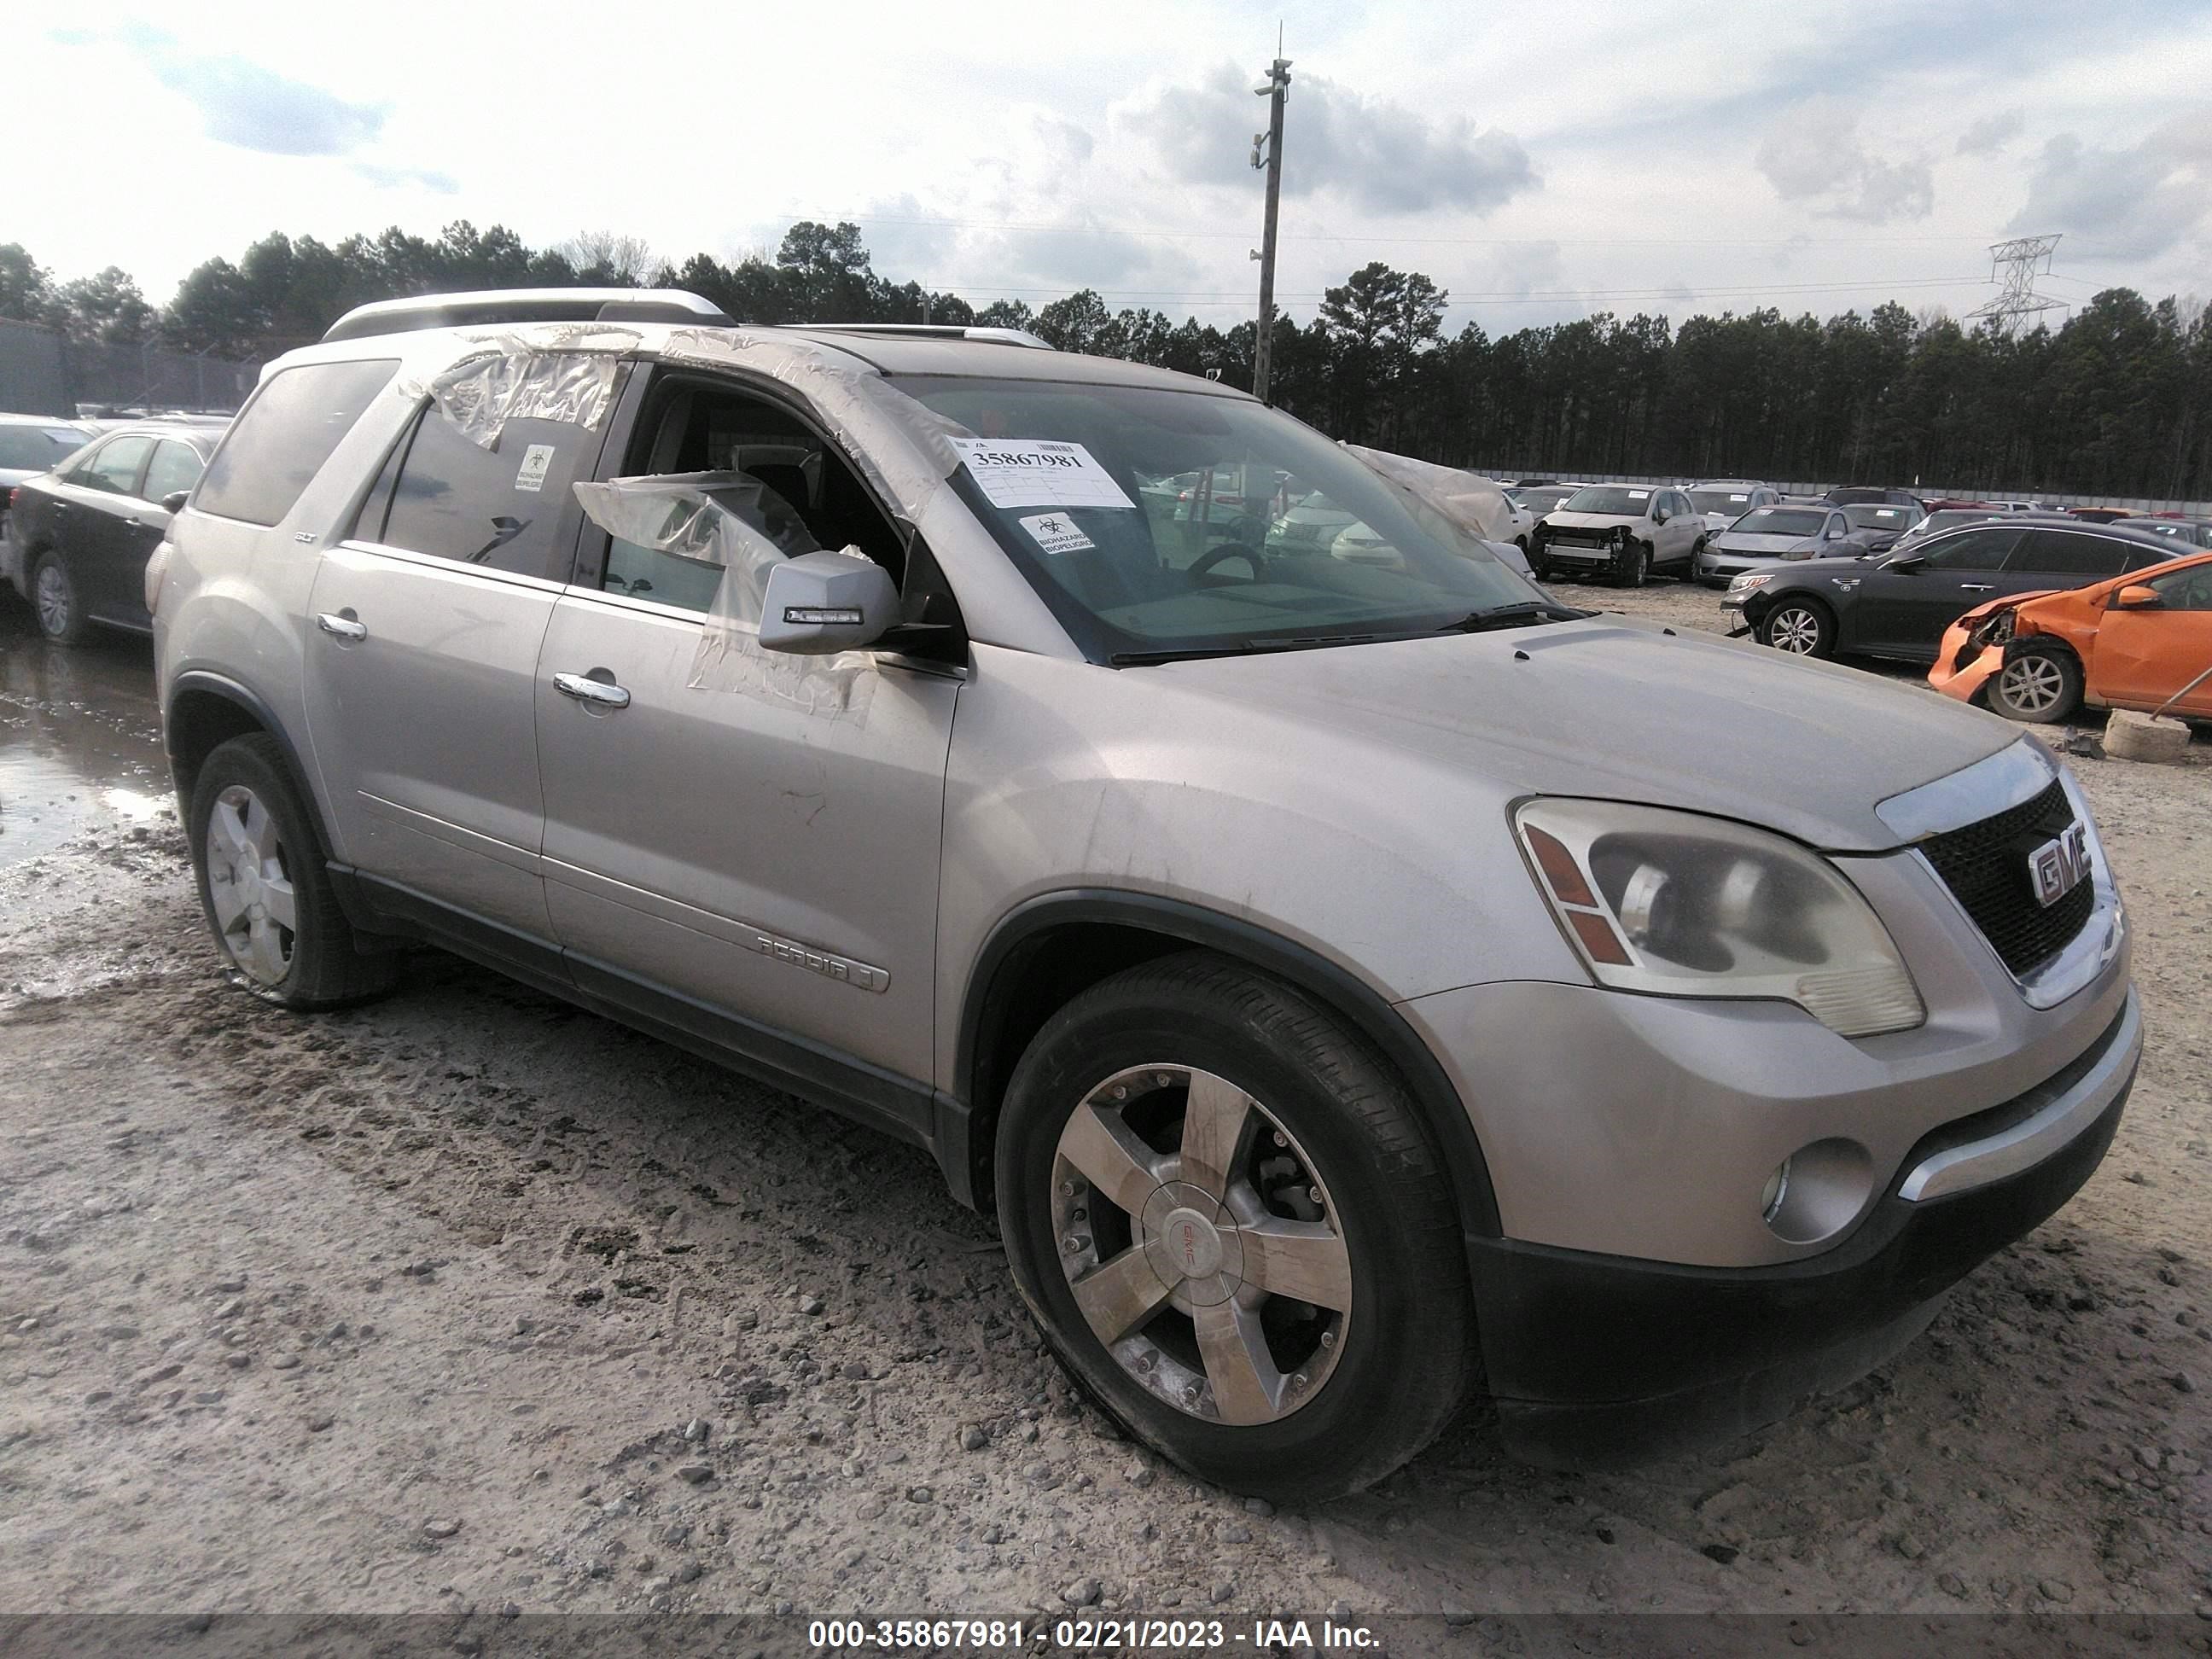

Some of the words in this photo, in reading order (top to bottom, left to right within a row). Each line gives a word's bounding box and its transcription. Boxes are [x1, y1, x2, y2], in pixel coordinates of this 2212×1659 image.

[972, 452, 1084, 468] 35867981
[1038, 533, 1086, 545] BIOHAZARD
[1045, 539, 1093, 552] BIOPELIGRO
[2029, 818, 2093, 908] GMC
[757, 936, 851, 980] ACADIA
[1184, 1225, 1195, 1265] GMC
